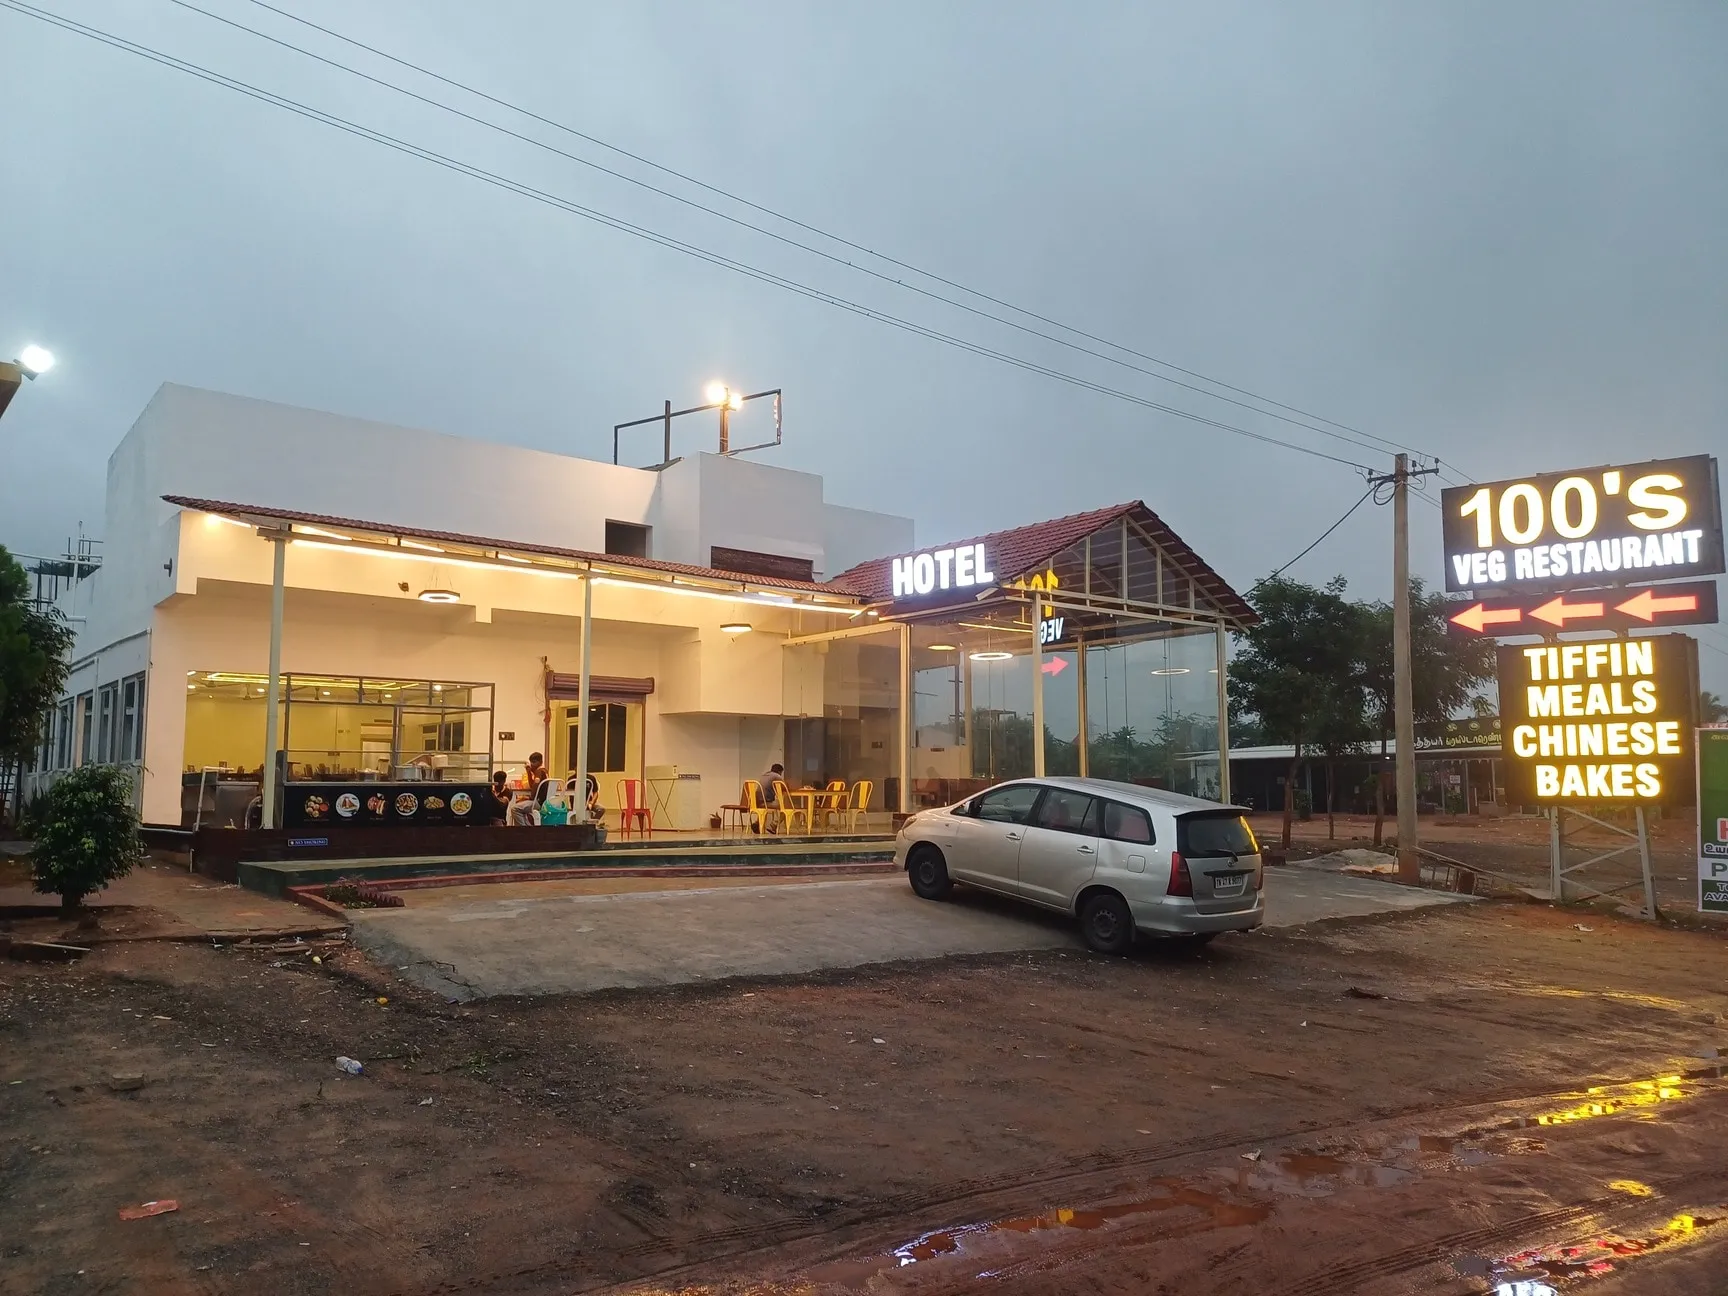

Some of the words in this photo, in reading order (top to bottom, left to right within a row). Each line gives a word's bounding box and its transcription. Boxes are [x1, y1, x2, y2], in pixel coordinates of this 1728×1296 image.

[1460, 471, 1687, 548] 100'S
[892, 543, 994, 597] HOTEL
[1452, 550, 1506, 585] VEG
[1514, 530, 1703, 580] RESTAURANT
[1523, 641, 1654, 681] TIFFIN
[1526, 680, 1657, 718] MEALS
[1512, 721, 1681, 758] CHINESE
[1535, 763, 1661, 797] BAKES
